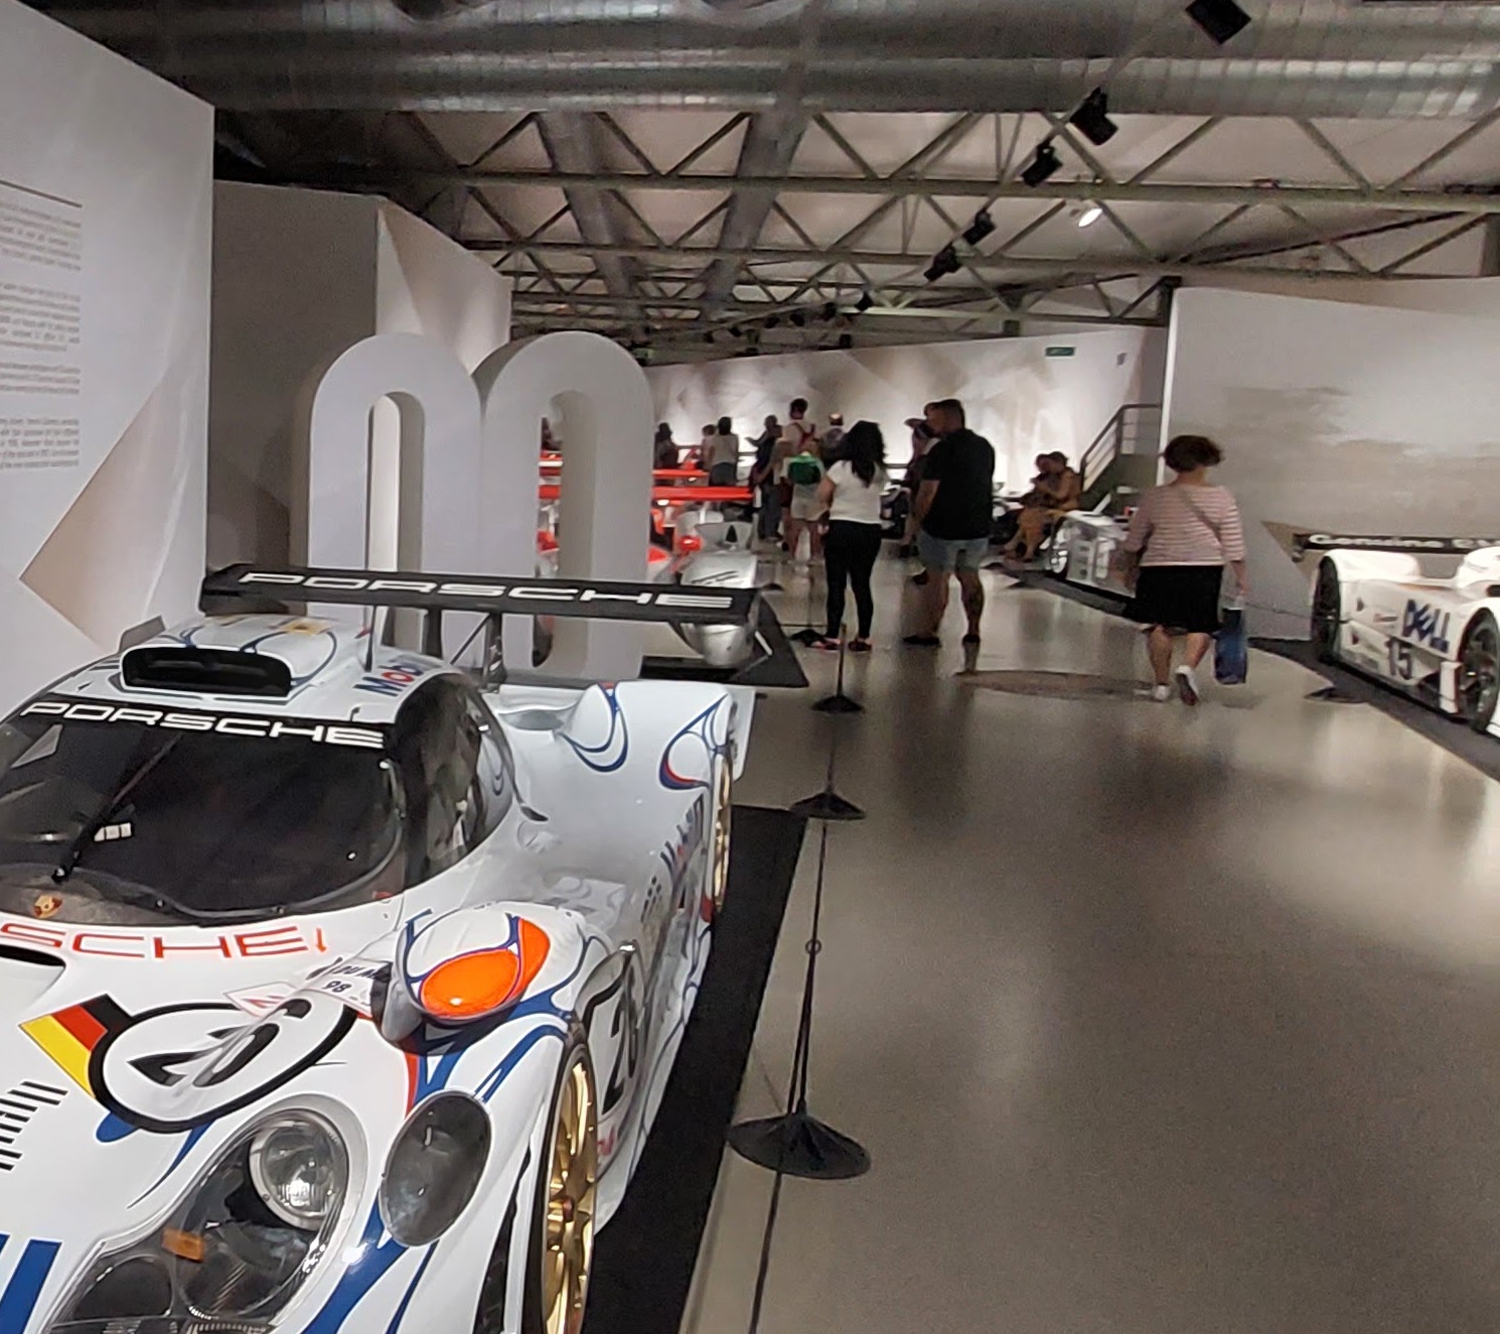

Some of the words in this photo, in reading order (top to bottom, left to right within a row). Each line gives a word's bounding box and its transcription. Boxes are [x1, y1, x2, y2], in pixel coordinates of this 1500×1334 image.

[238, 570, 734, 610] PORSCHE
[1402, 599, 1452, 654] DELL
[352, 662, 424, 698] Mob
[20, 699, 386, 751] PORSCHE
